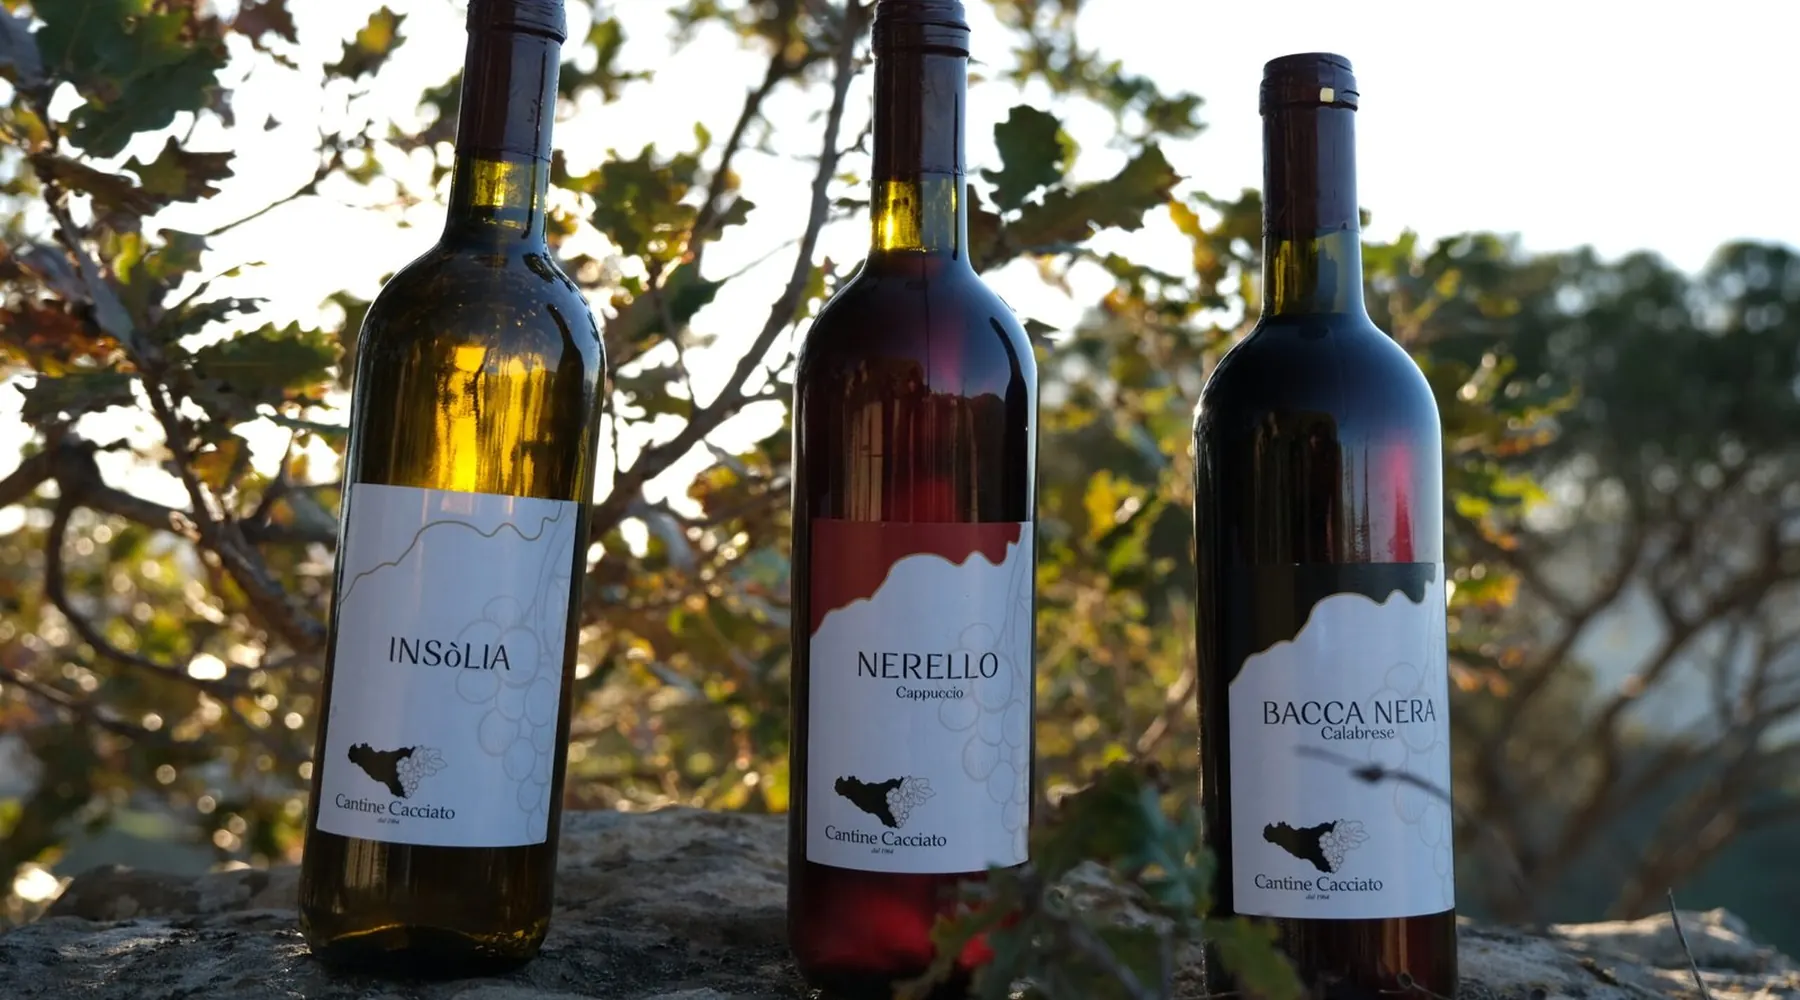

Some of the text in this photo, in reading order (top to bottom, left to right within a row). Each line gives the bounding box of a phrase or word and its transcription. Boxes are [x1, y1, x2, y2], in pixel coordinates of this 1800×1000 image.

[389, 636, 511, 671] INSòLIA
[857, 651, 999, 680] NERELLO
[895, 686, 964, 701] Cappuccio
[1263, 699, 1436, 725] BACCA NERA
[1321, 725, 1395, 740] Calabrese
[335, 793, 456, 820] Cantine Cacciato
[825, 825, 947, 848] Cantine Cacciato
[1254, 873, 1383, 892] Cantine Cacciato
